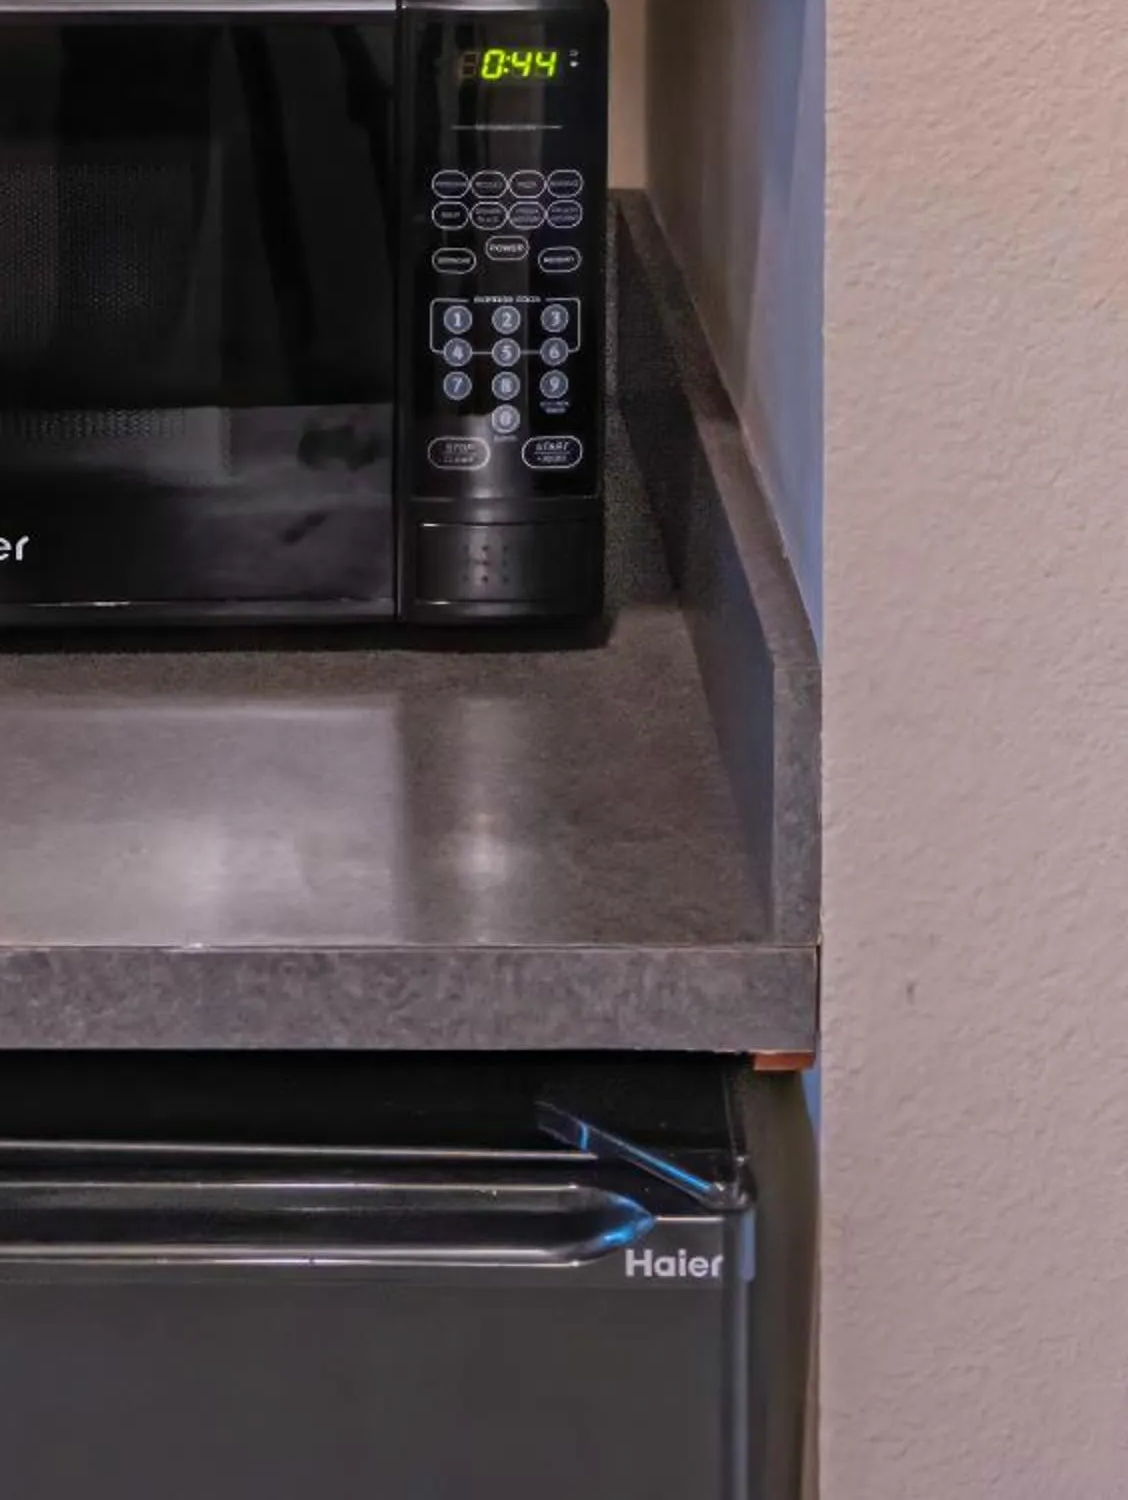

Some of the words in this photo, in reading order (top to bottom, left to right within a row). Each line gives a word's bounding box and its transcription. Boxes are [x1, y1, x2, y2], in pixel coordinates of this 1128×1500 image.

[480, 48, 558, 80] 0:44
[502, 312, 512, 328] 2
[551, 311, 561, 326] 3
[452, 345, 463, 360] 4
[501, 345, 512, 361] 5
[549, 344, 559, 359] 6
[452, 378, 462, 393] 7
[549, 377, 559, 392] 9
[625, 1248, 724, 1277] Haier
